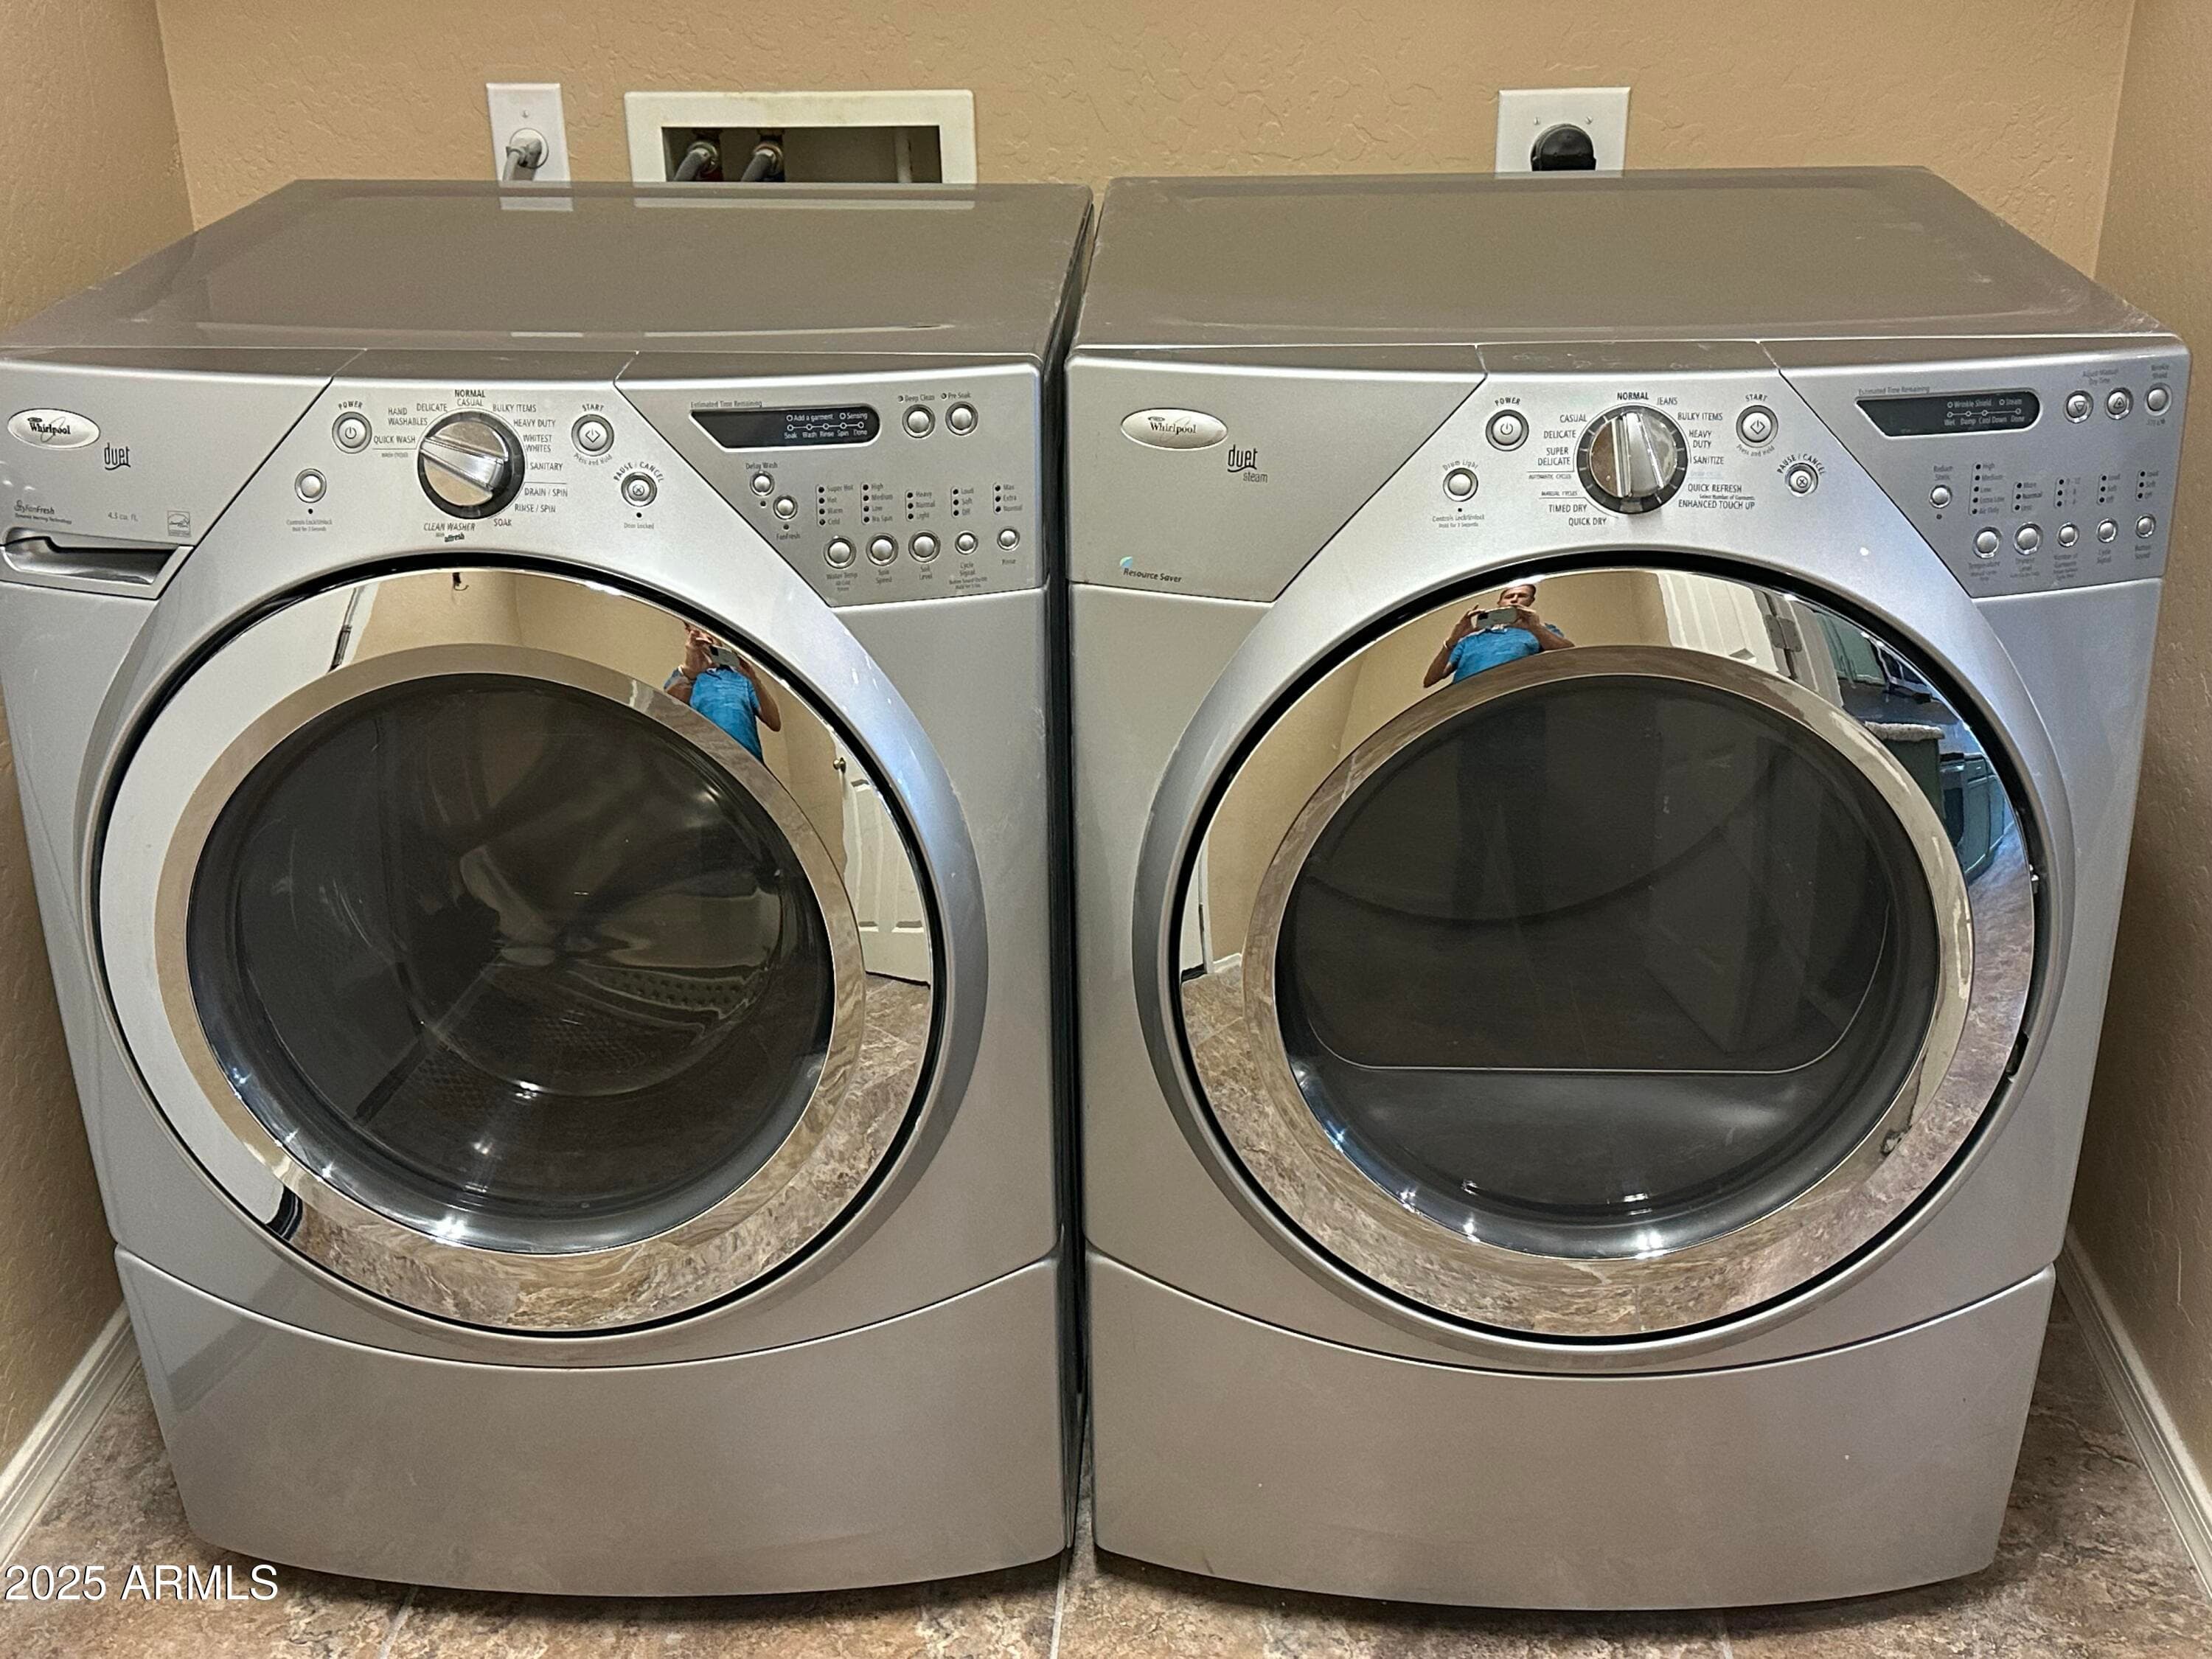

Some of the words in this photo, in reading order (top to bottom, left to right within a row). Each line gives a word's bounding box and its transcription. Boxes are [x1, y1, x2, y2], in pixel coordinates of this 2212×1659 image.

[454, 389, 486, 398] NORMAL
[958, 391, 971, 399] Soak
[1617, 392, 1649, 400] NORMAL
[1858, 388, 1886, 396] Estimated
[457, 398, 483, 406] CASUAL
[905, 394, 919, 403] Deep
[1495, 397, 1520, 406] POWER
[1656, 397, 1678, 406] JEANS
[1745, 394, 1769, 403] START
[338, 400, 363, 410] POWER
[417, 403, 448, 412] DELICATE
[493, 404, 514, 413] BULKY
[516, 404, 537, 413] ITEMS
[582, 403, 604, 411] START
[811, 414, 834, 422] garment
[846, 412, 868, 420] Sensing
[1559, 414, 1587, 423] CASUAL
[1677, 412, 1700, 420] BULKY
[1702, 412, 1723, 421] ITEMS
[388, 417, 428, 426] WASHABLES
[513, 419, 535, 428] HEAVY
[538, 419, 556, 428] DUTY
[29, 422, 72, 436] Whirlpool
[837, 429, 849, 437] Spin
[1150, 421, 1197, 436] Whirlpool
[523, 434, 552, 442] WHITEST
[784, 431, 798, 439] Soak
[1543, 430, 1576, 439] DELICATE
[1688, 429, 1712, 438] HEAVY
[373, 435, 394, 445] QUICK
[1692, 440, 1712, 449] DUTY
[525, 444, 552, 453] WHITES
[1546, 447, 1568, 456] SUPER
[1736, 444, 1750, 456] Press
[1750, 449, 1761, 457] and
[1762, 445, 1775, 456] Hold
[104, 442, 131, 467] duet
[1228, 445, 1258, 470] duet
[574, 453, 587, 465] Press
[588, 457, 599, 466] and
[600, 454, 613, 465] Hold
[1537, 457, 1571, 466] DELICATE
[1693, 456, 1725, 465] SANITIZE
[1777, 454, 1797, 474] PAUSE
[1803, 453, 1826, 475] CANCEL
[530, 462, 563, 471] SANITARY
[745, 462, 762, 472] Delay
[1442, 460, 1461, 471] Drum
[1462, 459, 1478, 470] Light
[613, 462, 633, 481] PAUSE
[639, 462, 664, 483] CANCEL
[1242, 471, 1268, 483] steam
[524, 488, 546, 496] DRAIN
[552, 488, 568, 497] SPIN
[1688, 483, 1710, 493] QUICK
[1711, 484, 1742, 493] REFRESH
[915, 491, 933, 499] Heavy
[515, 504, 534, 512] RINSE
[540, 504, 556, 513] SPIN
[1548, 504, 1571, 513] TIMED
[1573, 504, 1587, 513] DRY
[1678, 499, 1717, 509] ENHANCED
[1719, 501, 1743, 509] TOUCH
[1745, 501, 1756, 510] UP
[493, 518, 512, 526] SOAK
[1568, 517, 1591, 527] QUICK
[1593, 517, 1607, 526] DRY
[423, 523, 445, 532] CLEAN
[447, 523, 476, 532] WASHER
[776, 532, 801, 541] FanFresh
[960, 561, 974, 570] Cycle
[1123, 568, 1159, 581] Resource
[1160, 572, 1182, 583] Saver
[875, 576, 892, 585] Speed
